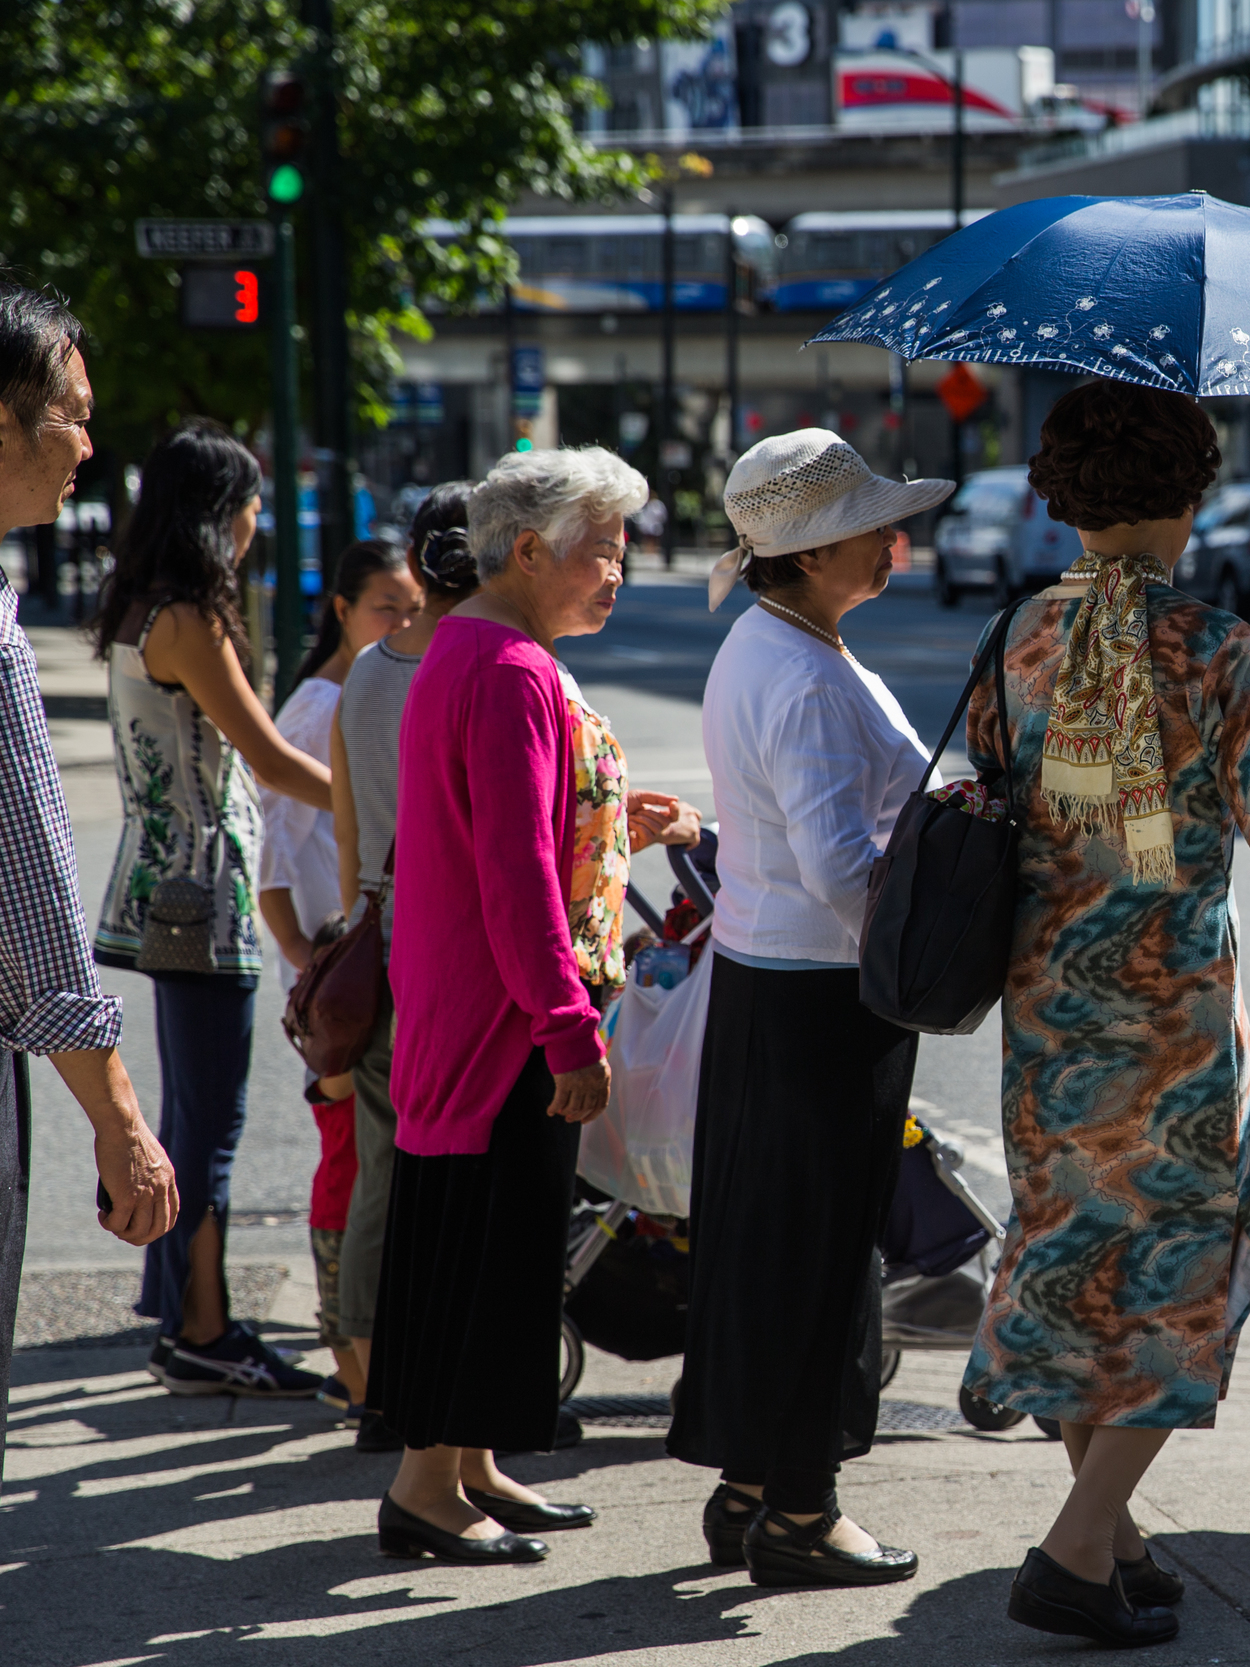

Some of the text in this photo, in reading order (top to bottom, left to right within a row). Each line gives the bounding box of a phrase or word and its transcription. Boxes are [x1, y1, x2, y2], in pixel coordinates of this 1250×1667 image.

[768, 2, 810, 67] 3
[149, 226, 231, 250] KEEFER
[234, 271, 258, 323] 3
